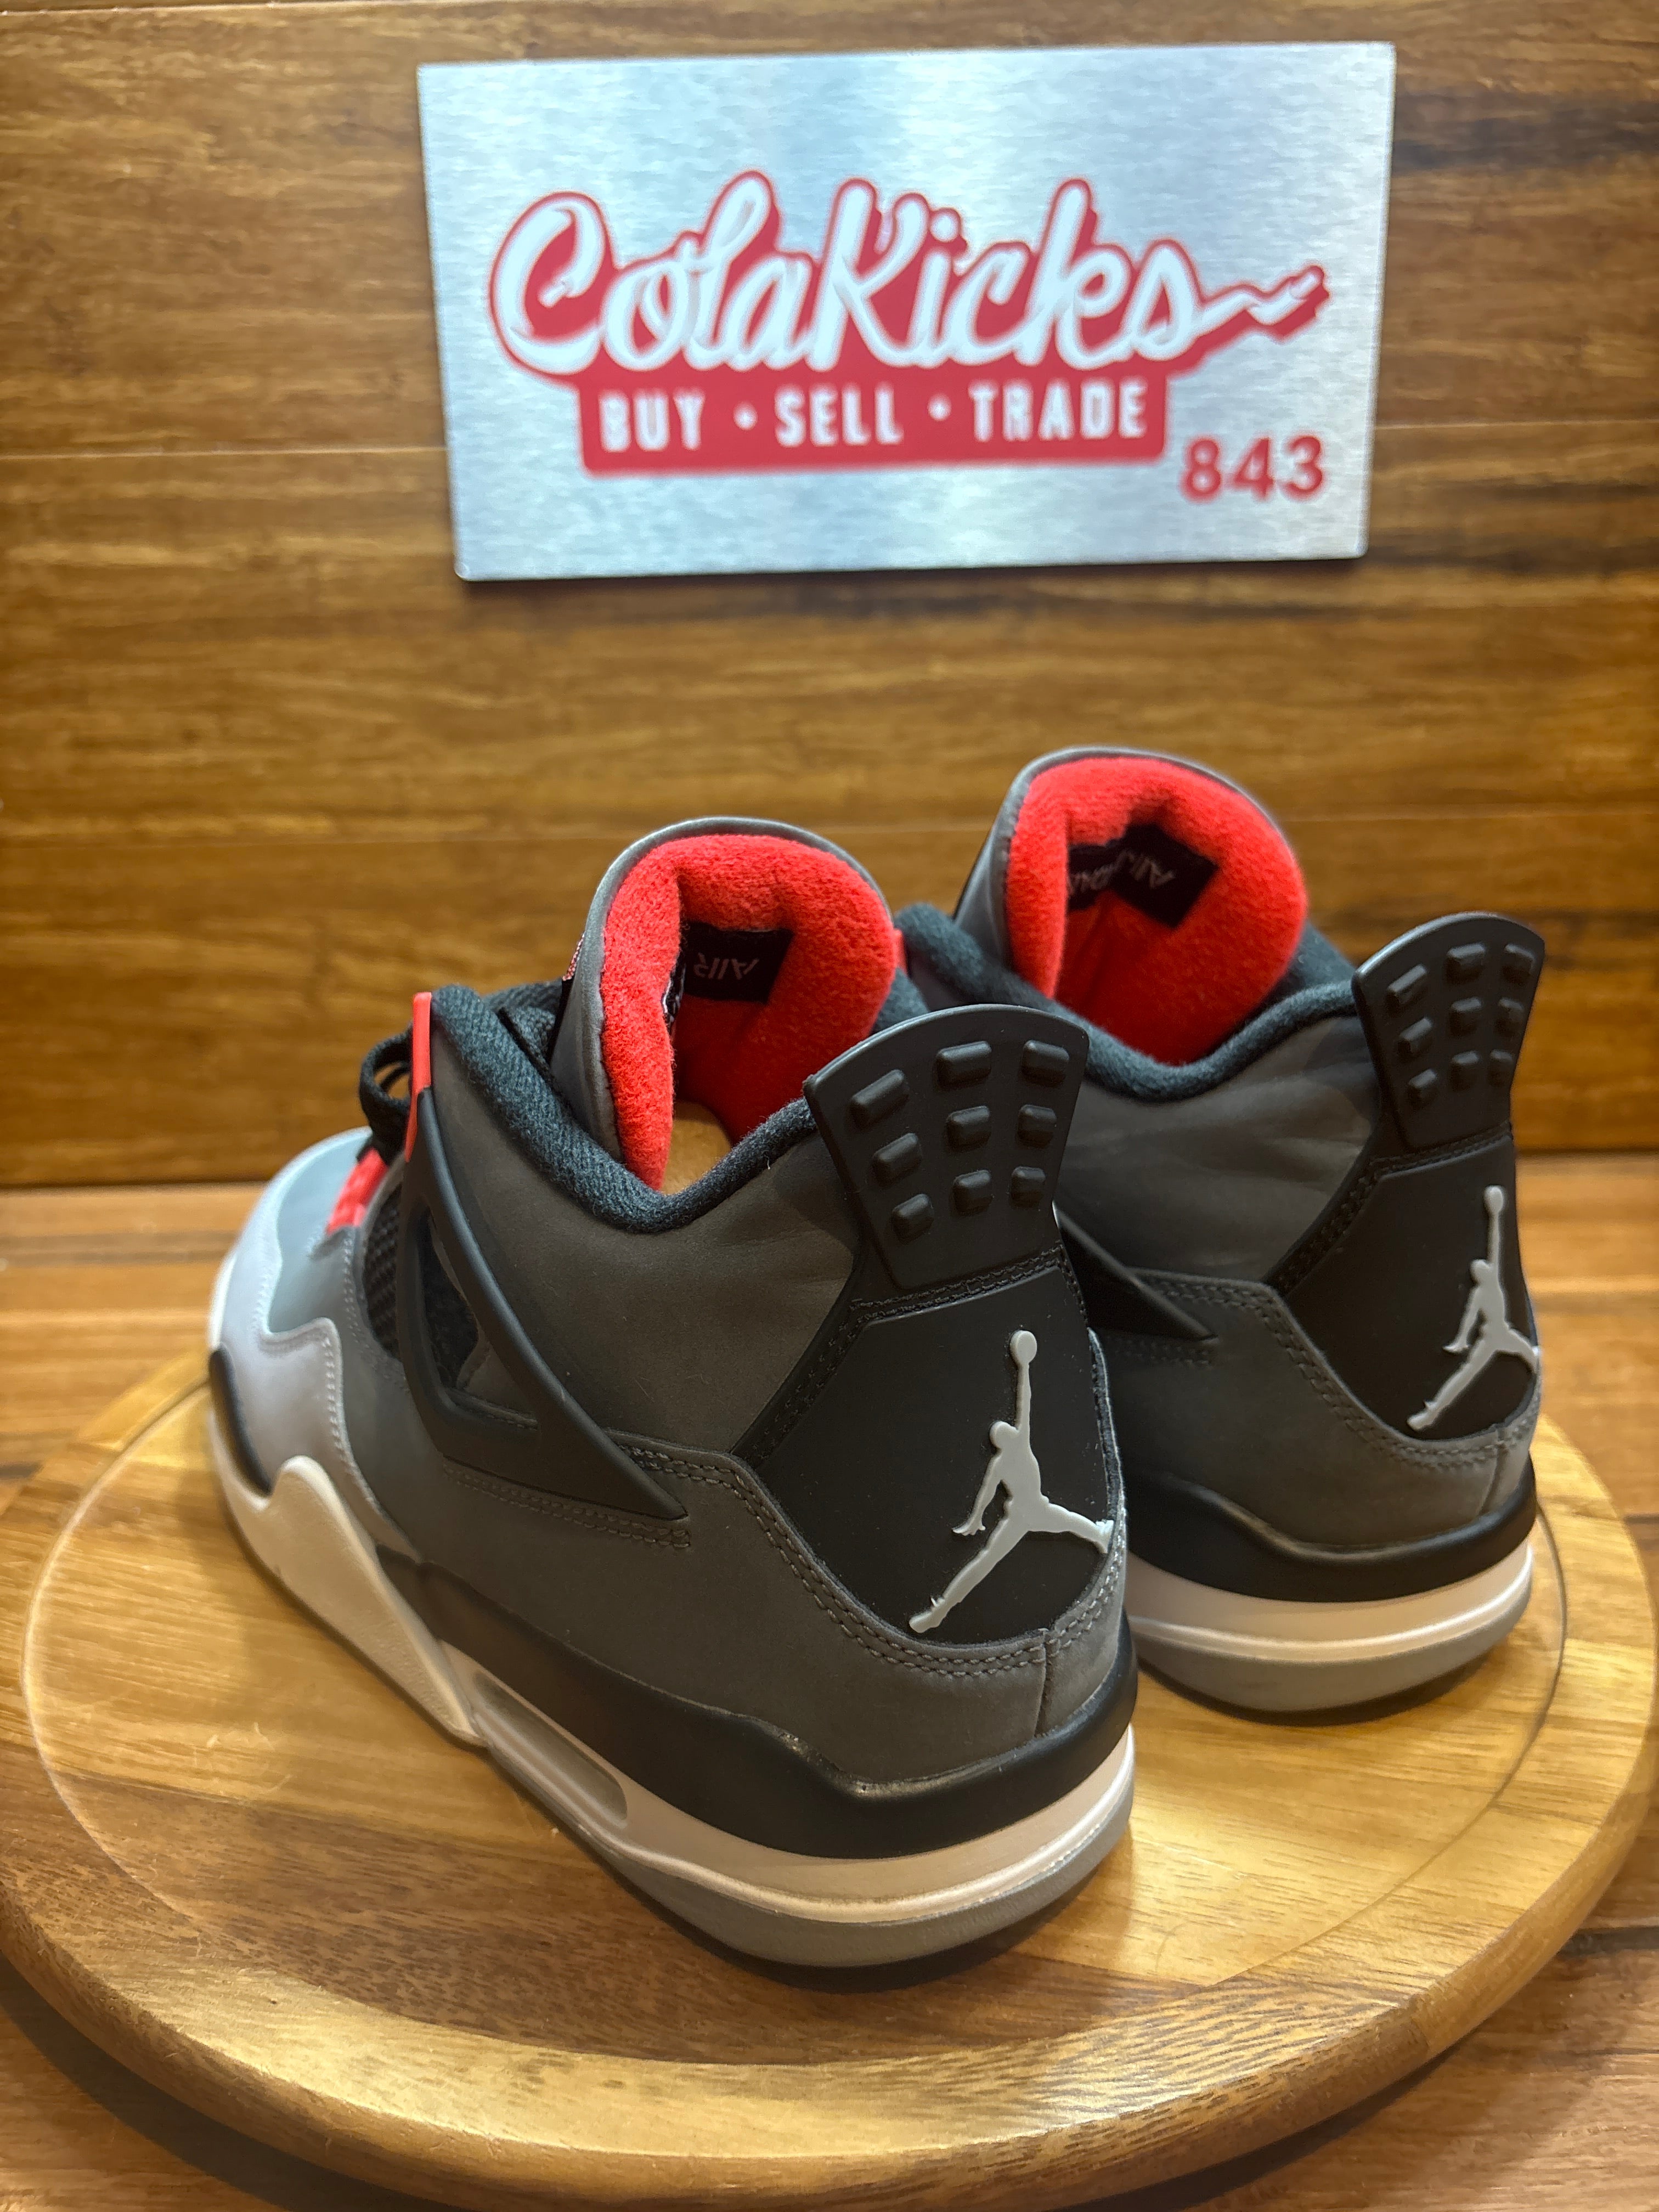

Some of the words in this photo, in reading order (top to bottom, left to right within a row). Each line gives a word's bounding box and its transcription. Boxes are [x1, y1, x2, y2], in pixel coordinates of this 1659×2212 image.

[598, 387, 706, 453] BUY
[774, 382, 904, 448] SELL
[968, 378, 1148, 441] TRADE
[1180, 432, 1323, 501] 843
[693, 952, 760, 980] AIR
